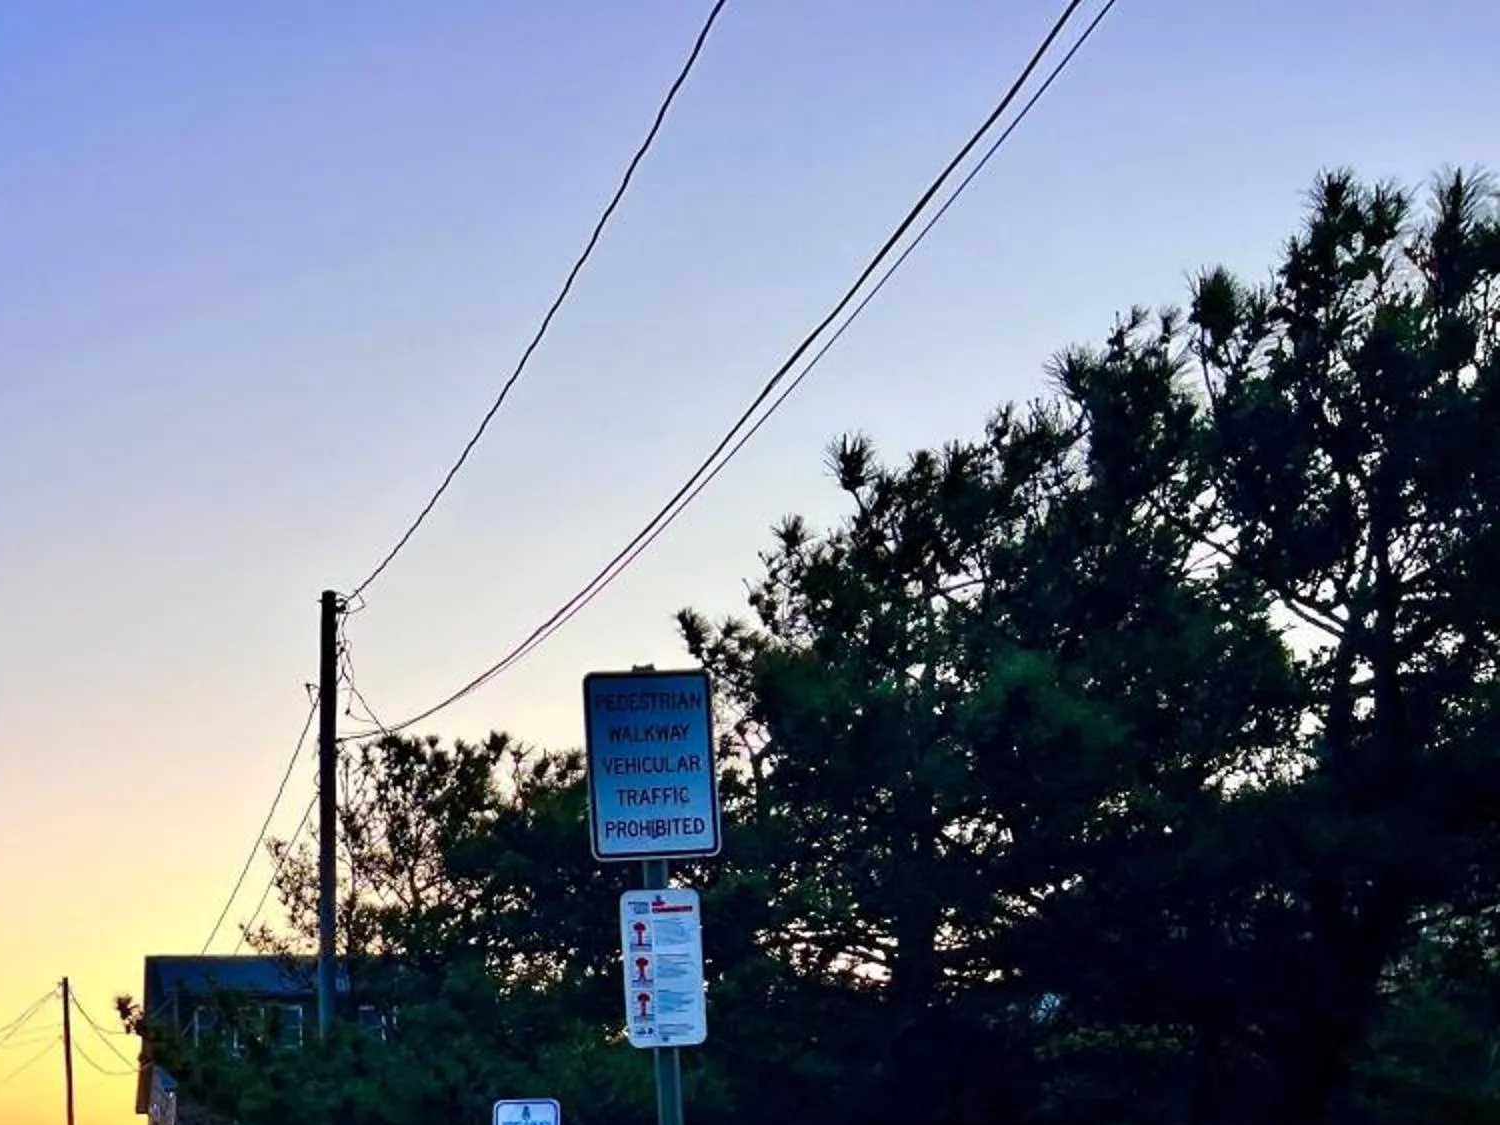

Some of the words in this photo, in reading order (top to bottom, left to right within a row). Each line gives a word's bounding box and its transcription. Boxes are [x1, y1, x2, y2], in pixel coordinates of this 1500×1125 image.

[596, 690, 700, 713] PEDESTRIAN
[610, 724, 689, 743] WALKWAY
[603, 755, 702, 775] VEHICULAR
[617, 785, 691, 806] TRAFFIC
[605, 817, 706, 839] PROHIBITED
